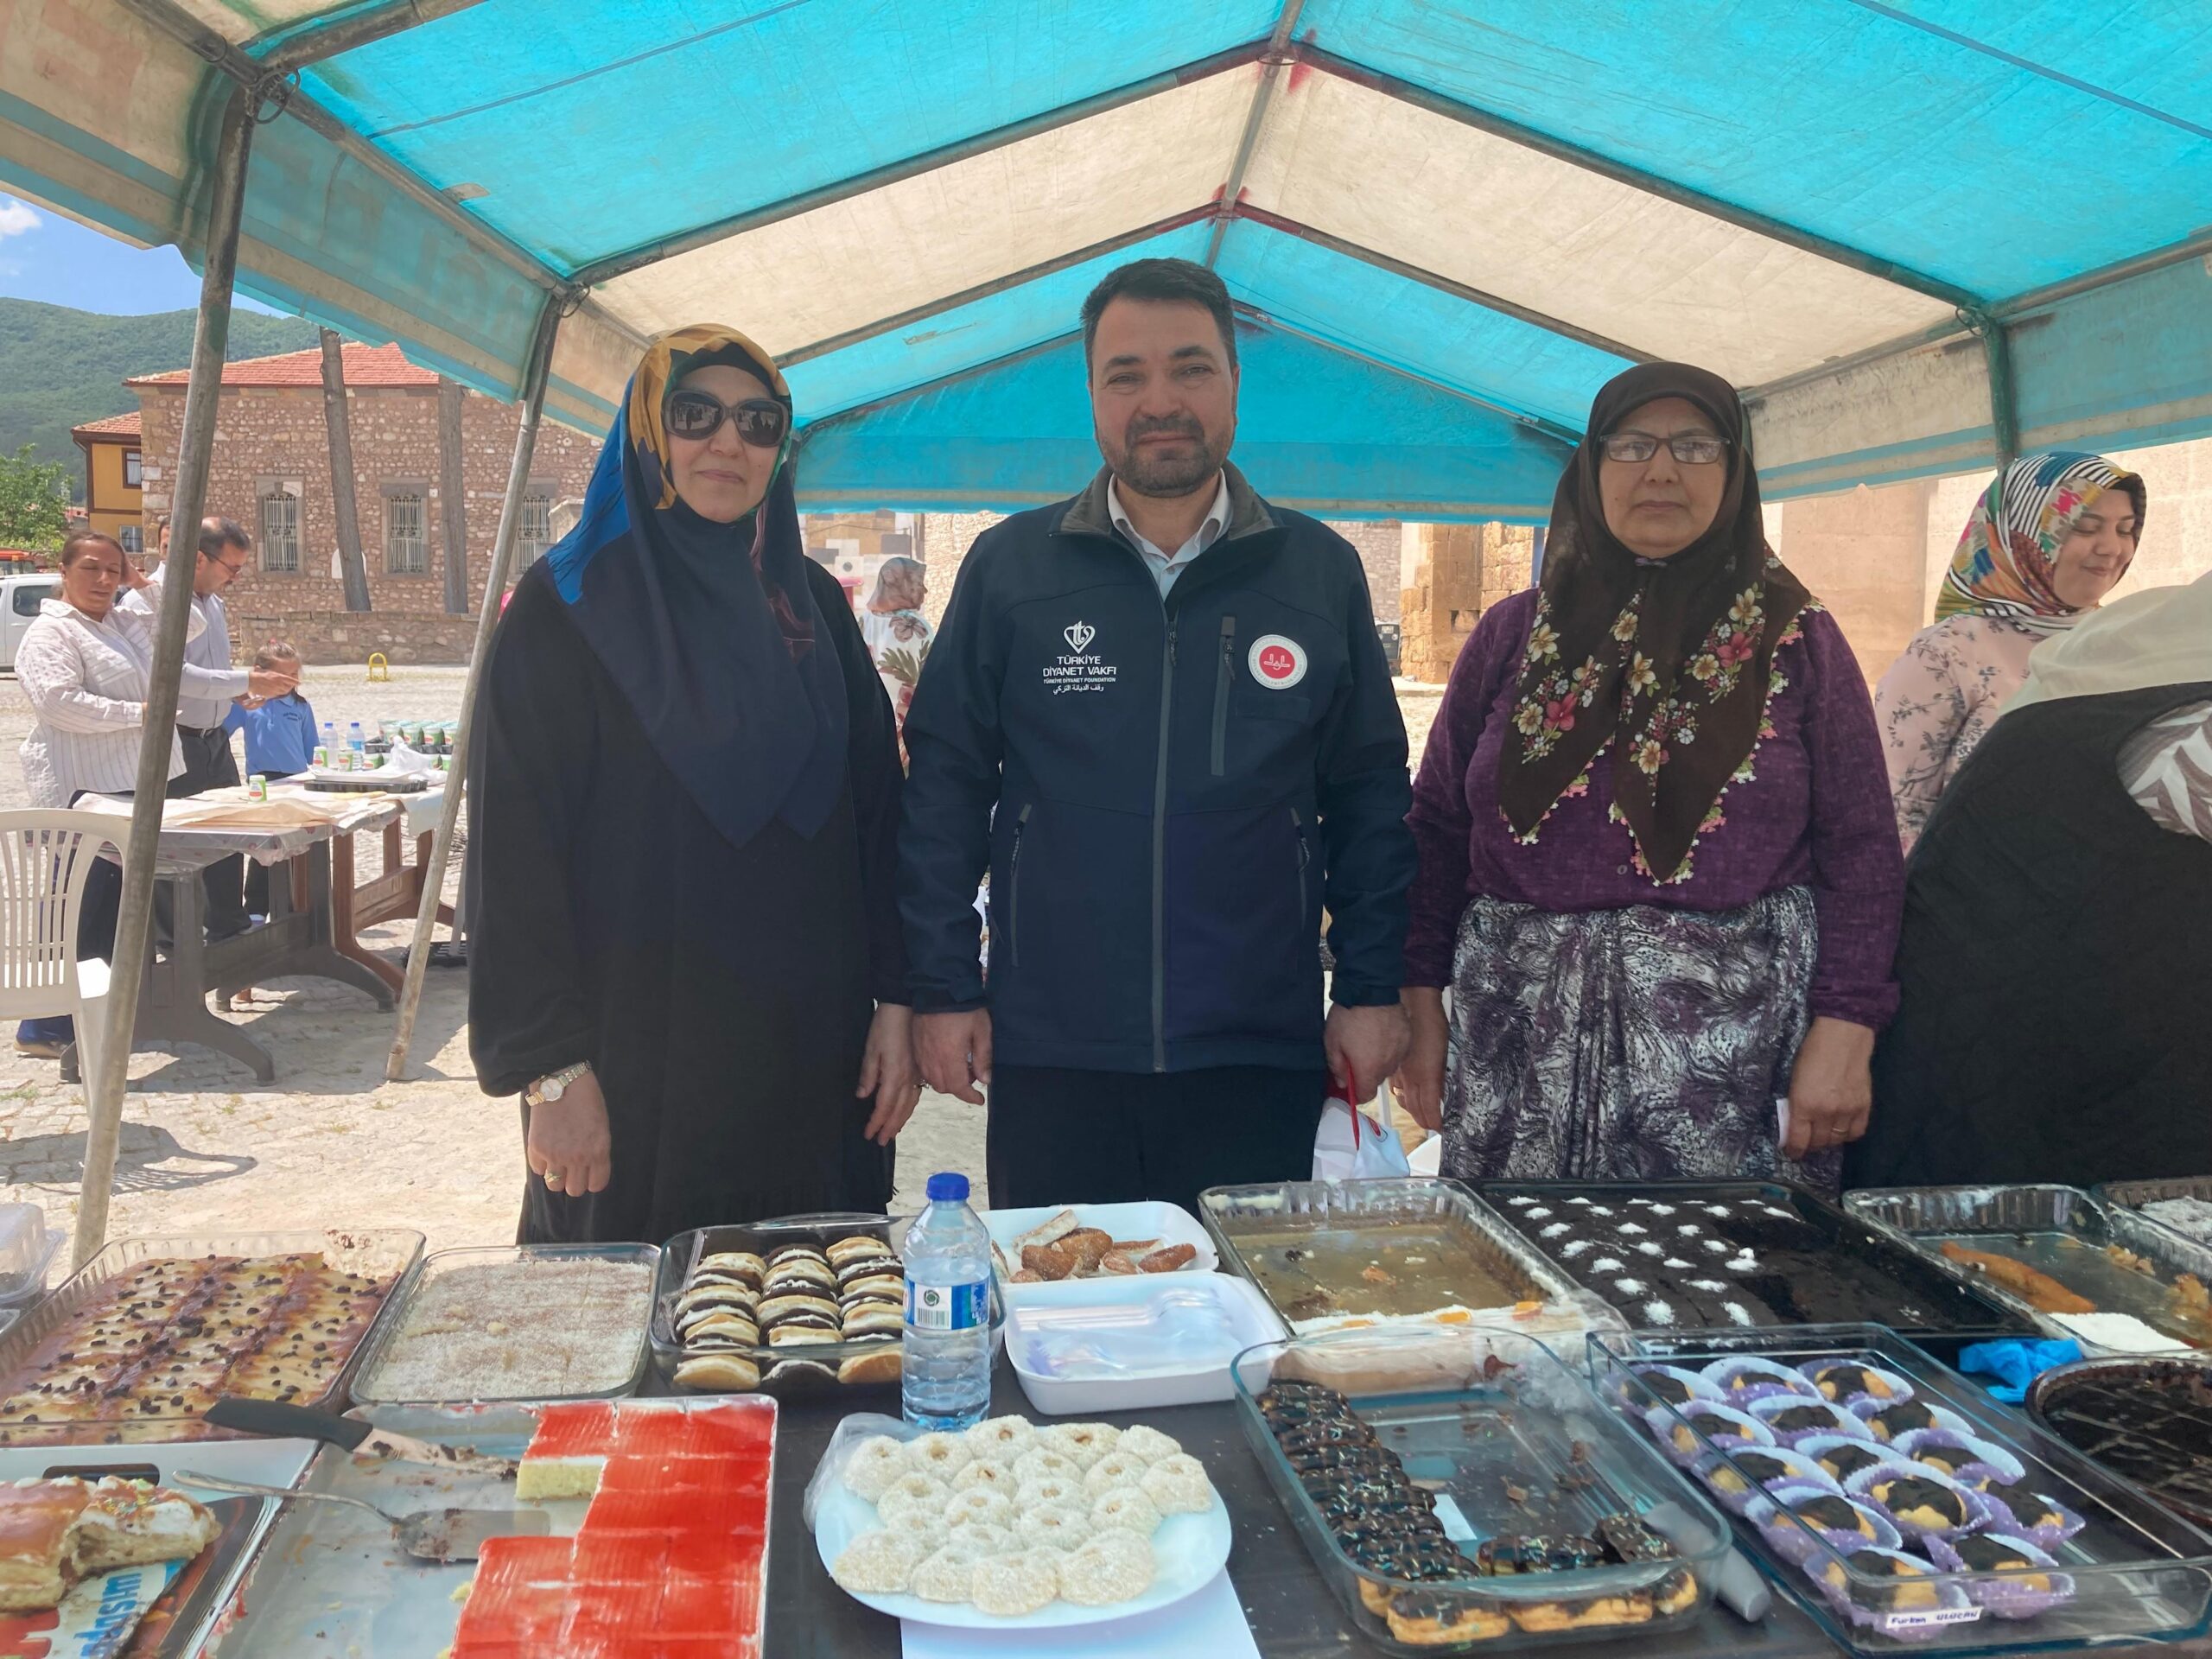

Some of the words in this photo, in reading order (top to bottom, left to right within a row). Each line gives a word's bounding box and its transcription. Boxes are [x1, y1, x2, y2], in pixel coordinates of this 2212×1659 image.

[1057, 654, 1102, 665] TÜRKİYE
[1042, 666, 1084, 677] DİYANET
[1087, 666, 1117, 676] VAKFI
